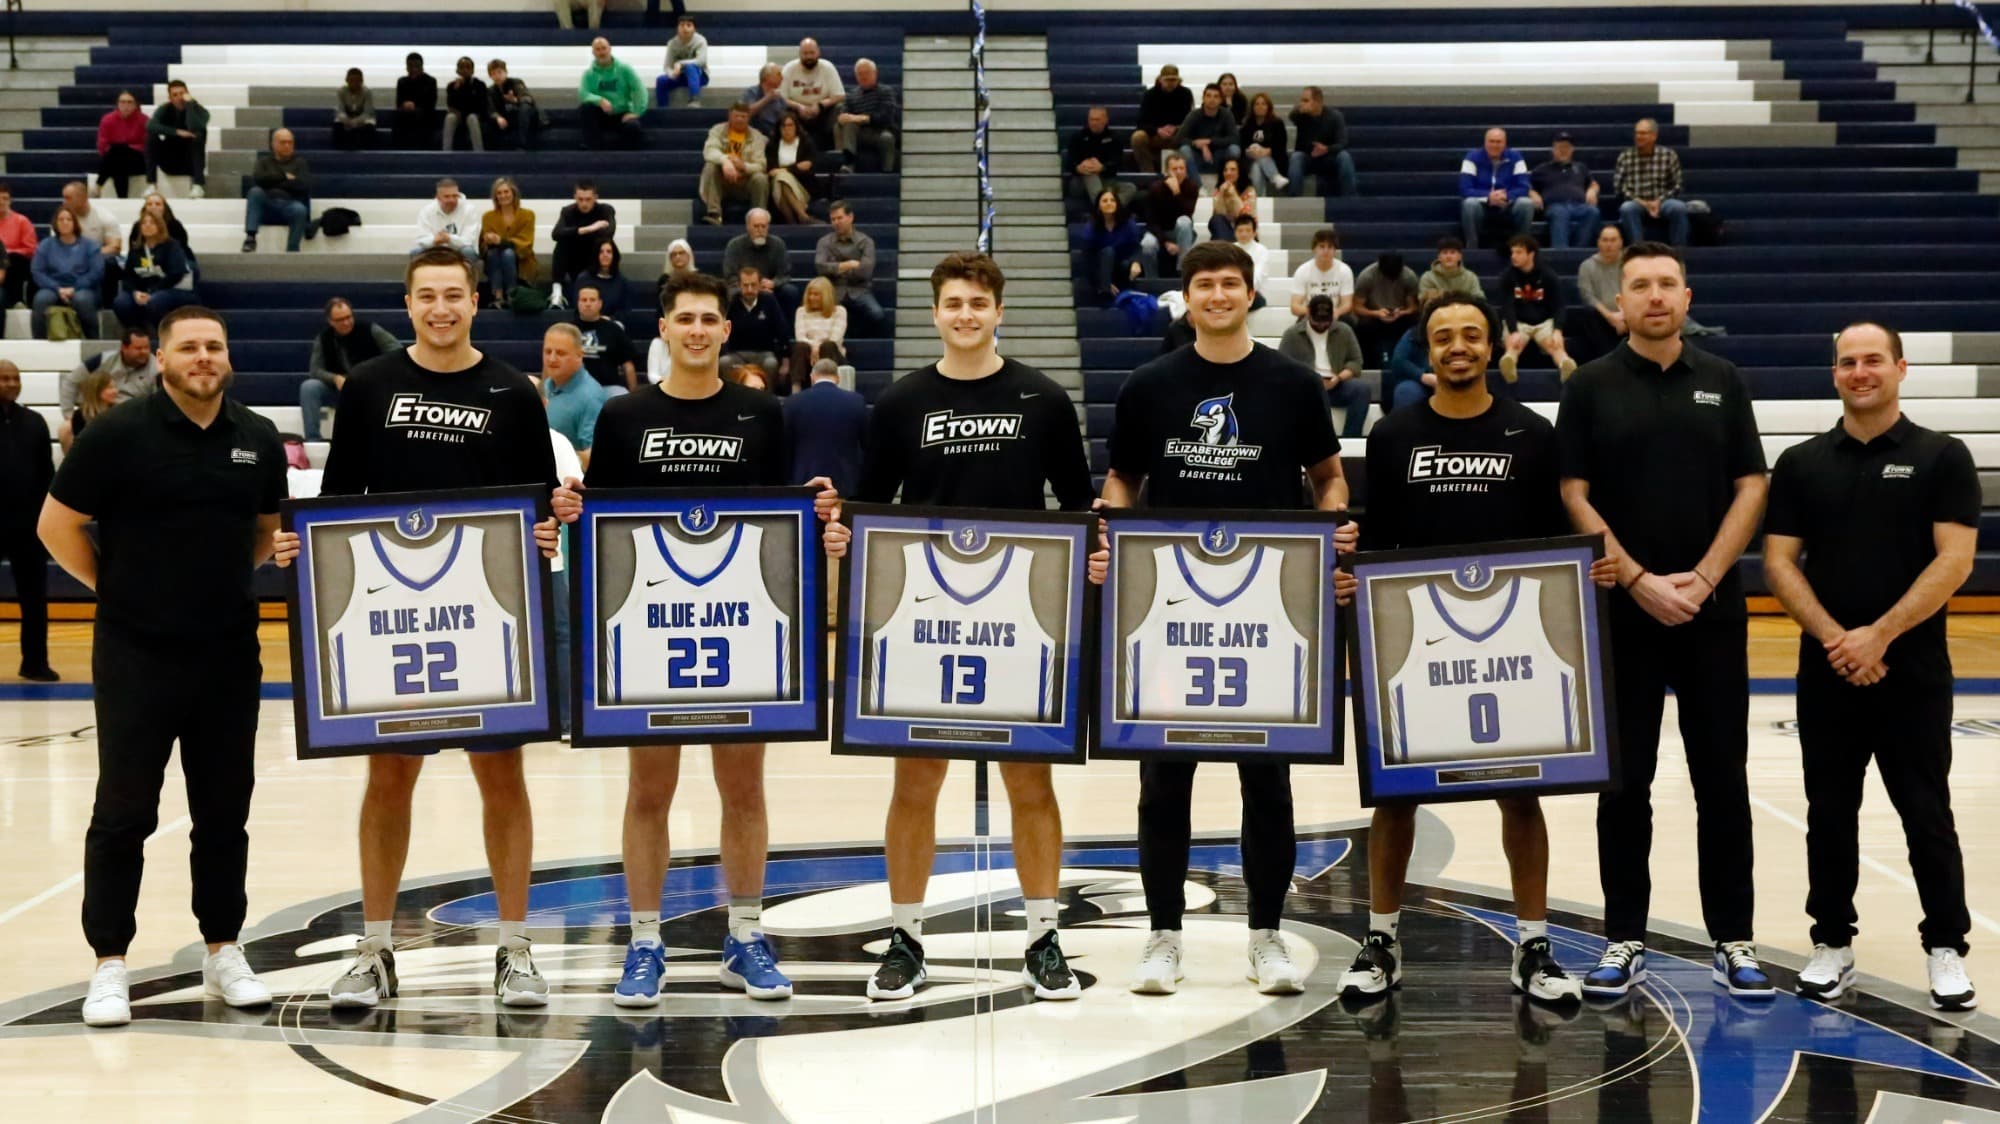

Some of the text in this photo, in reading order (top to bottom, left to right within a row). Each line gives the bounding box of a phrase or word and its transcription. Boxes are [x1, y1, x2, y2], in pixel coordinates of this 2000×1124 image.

[391, 397, 485, 428] ETOWN
[407, 430, 465, 443] BASKETBALL
[927, 415, 1017, 442] ETOWN
[643, 432, 738, 457] ETOWN
[943, 442, 1000, 455] BASKETBALL
[1167, 441, 1258, 457] ELIZABETHTOWN
[661, 463, 721, 472] BASKETBALL
[1187, 454, 1235, 466] COLLEGE
[1412, 450, 1506, 477] ETOWN
[1179, 470, 1243, 481] BASKETBALL
[1430, 483, 1489, 493] BASKETBALL
[369, 604, 475, 636] BLUE JAYS
[646, 601, 750, 629] BLUE JAYS
[913, 619, 1016, 647] BLUE JAYS
[1166, 621, 1268, 648] BLUE JAYS
[391, 641, 459, 695] 22
[667, 637, 730, 689] 23
[1427, 655, 1533, 687] BLUE JAYS
[939, 654, 987, 705] 13
[1185, 656, 1248, 707] 33
[1467, 692, 1501, 744] 0
